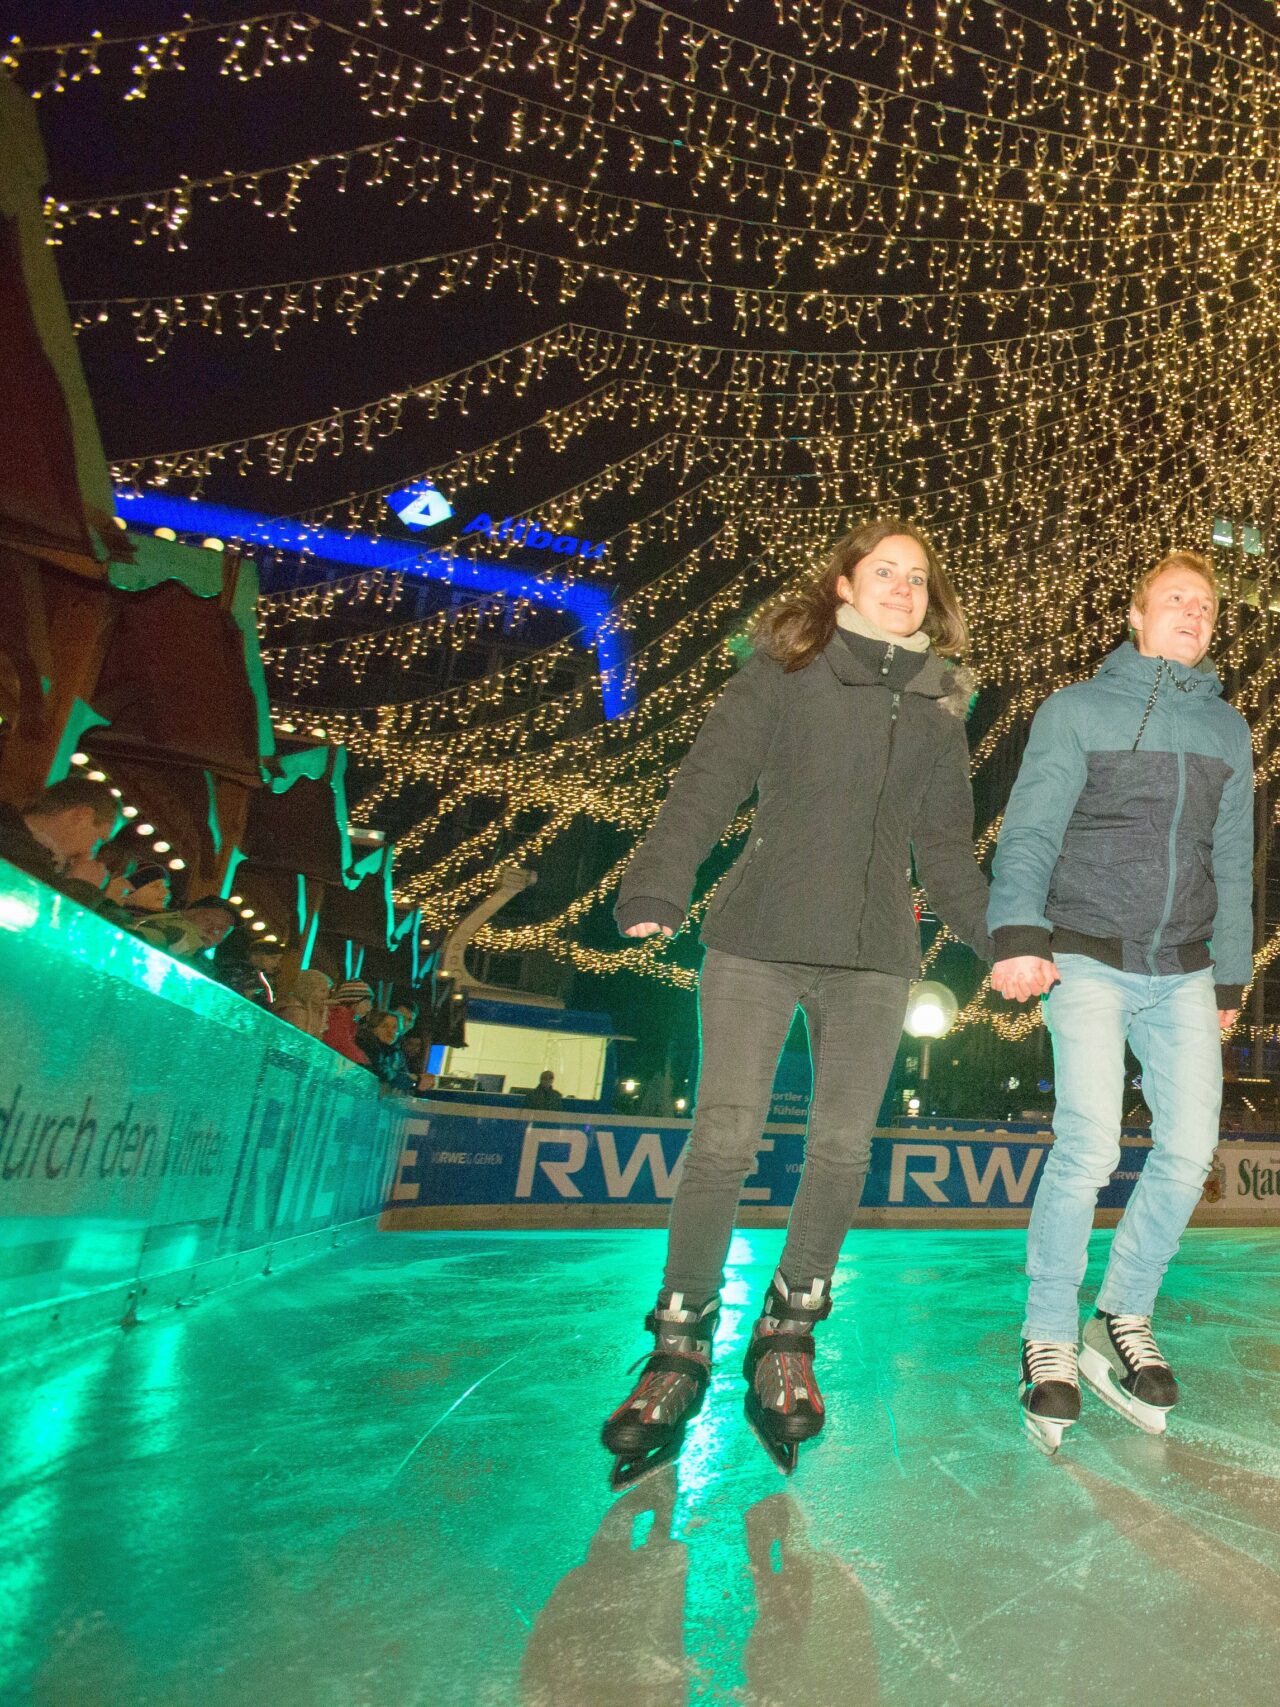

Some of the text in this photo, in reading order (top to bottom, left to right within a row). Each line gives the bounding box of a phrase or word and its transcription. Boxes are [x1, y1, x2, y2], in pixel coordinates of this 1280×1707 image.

[0, 1084, 97, 1180] durch
[100, 1102, 157, 1178] den
[888, 1143, 1045, 1203] RW
